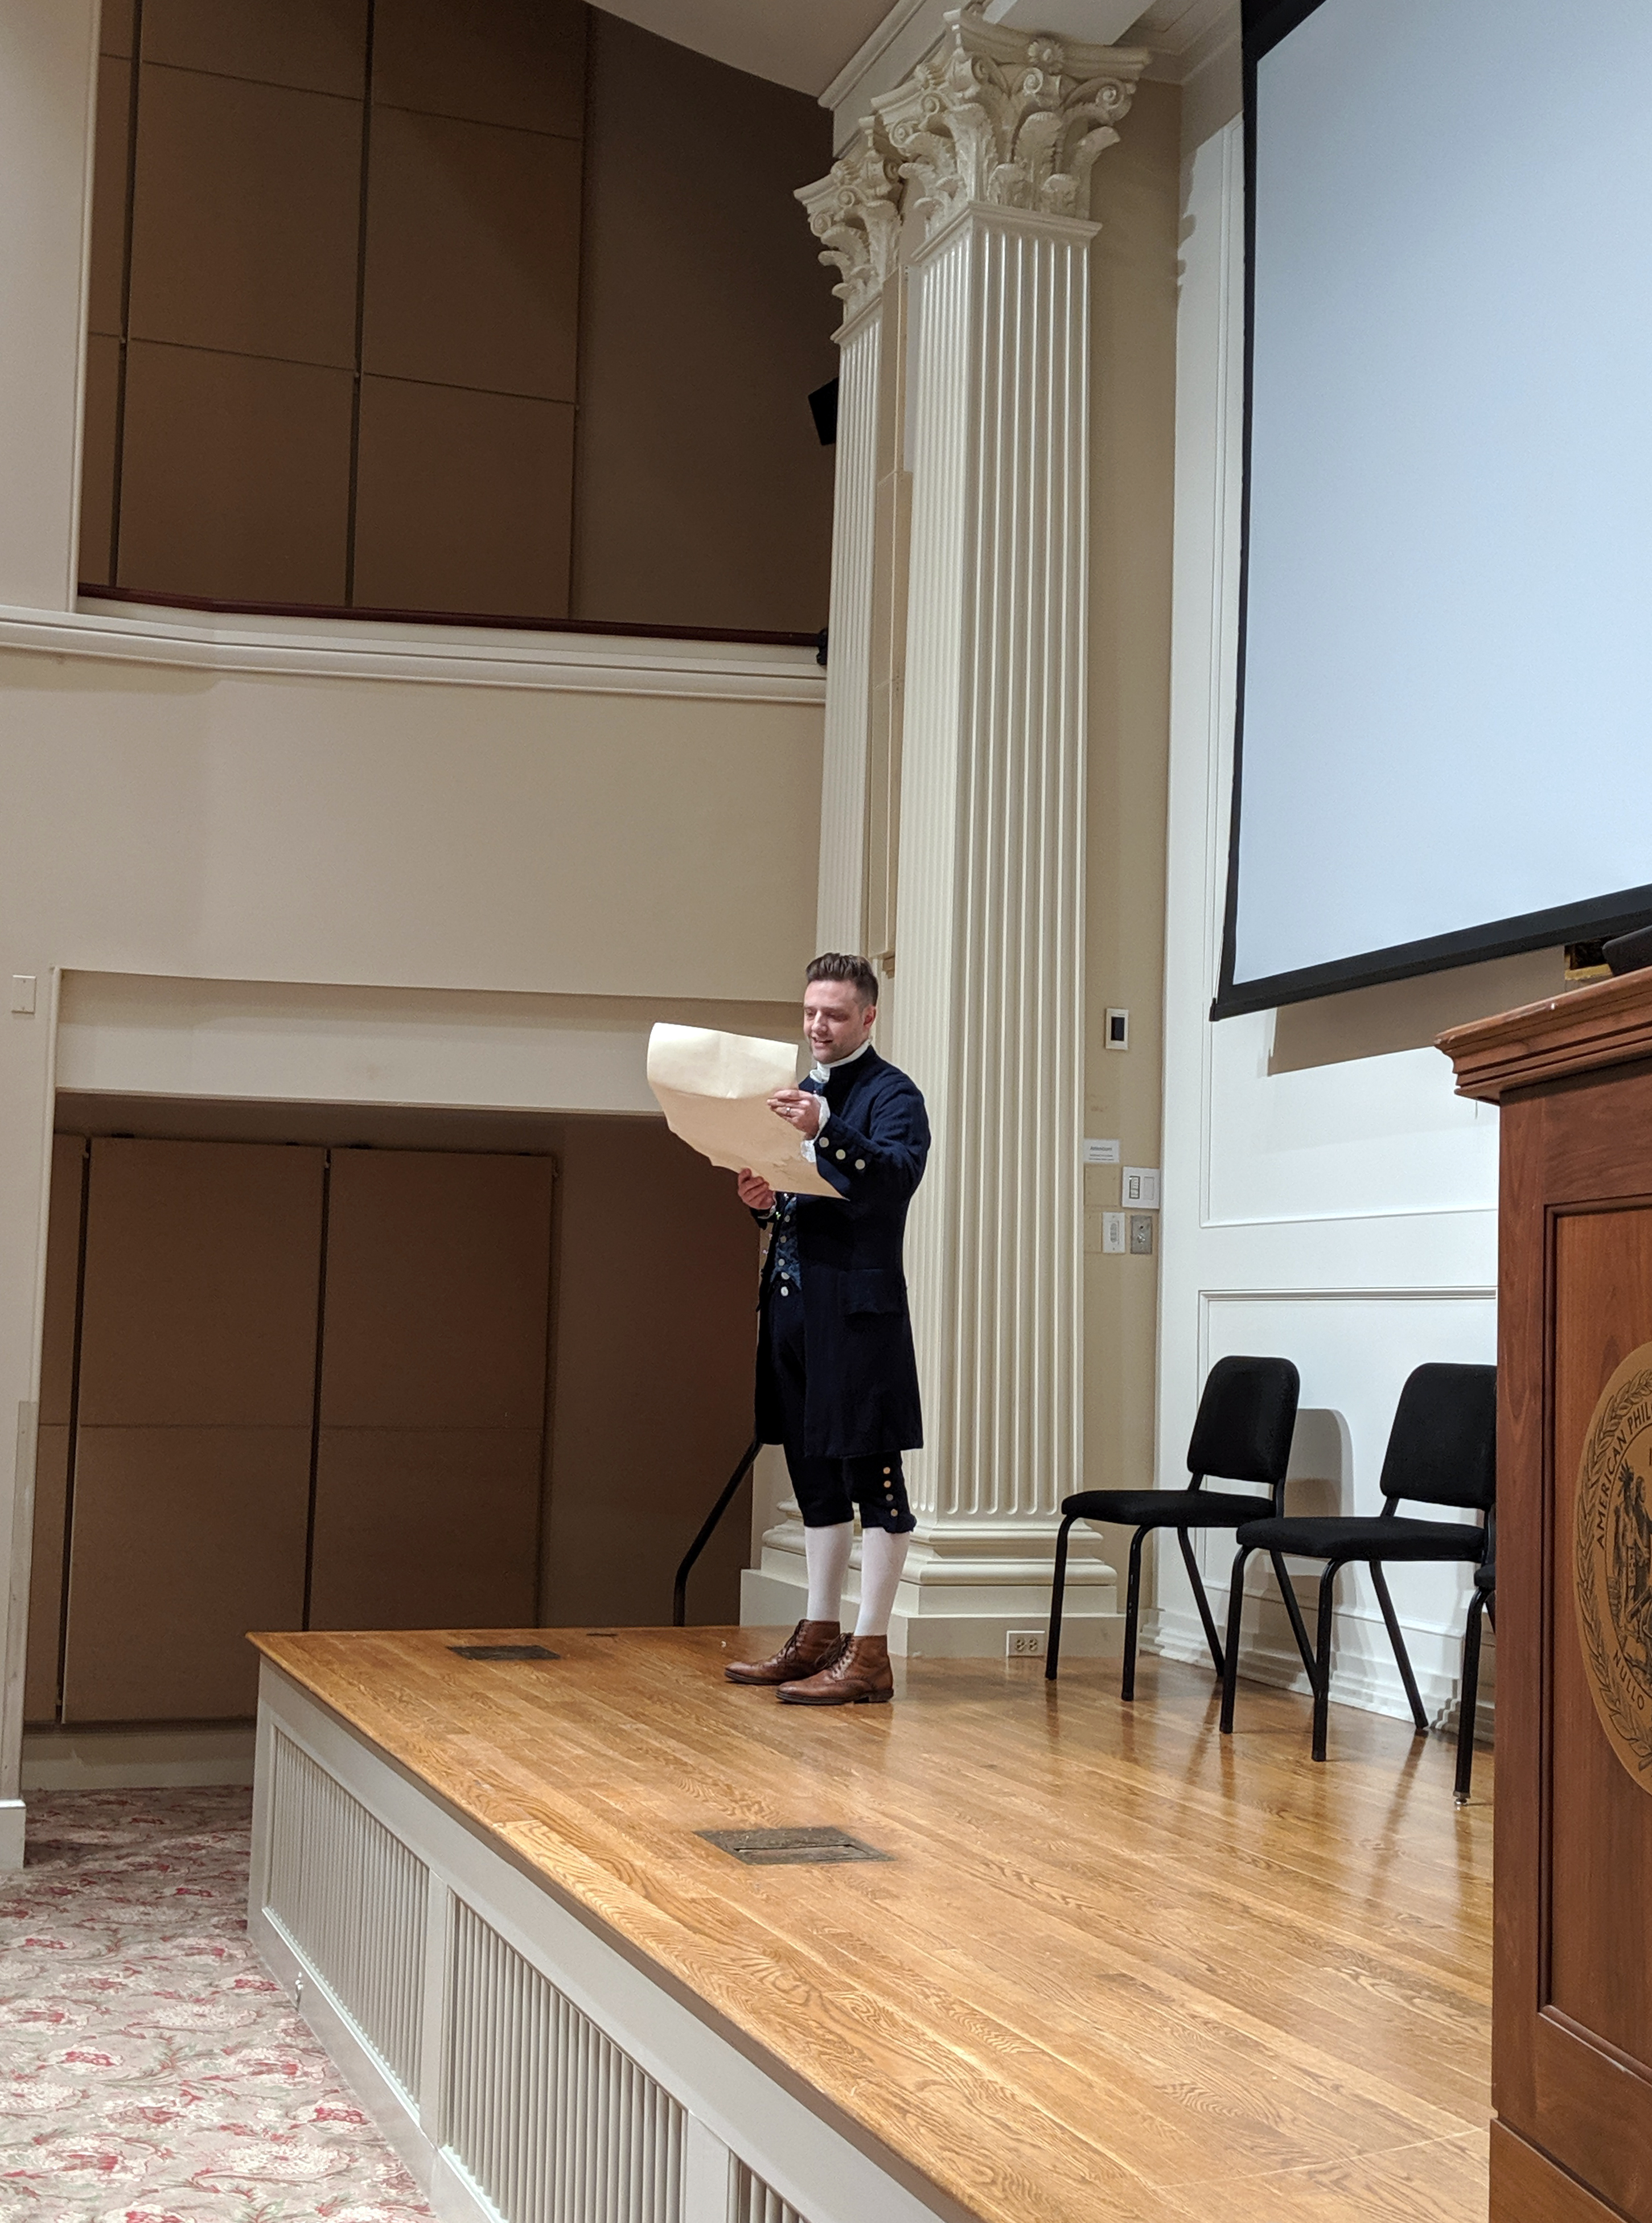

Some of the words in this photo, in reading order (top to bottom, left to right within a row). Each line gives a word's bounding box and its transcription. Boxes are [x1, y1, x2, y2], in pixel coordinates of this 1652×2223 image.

[1596, 1429, 1627, 1551] AMERICAN
[1627, 1401, 1652, 1435] PHIL
[1613, 1649, 1645, 1711] NULLO
